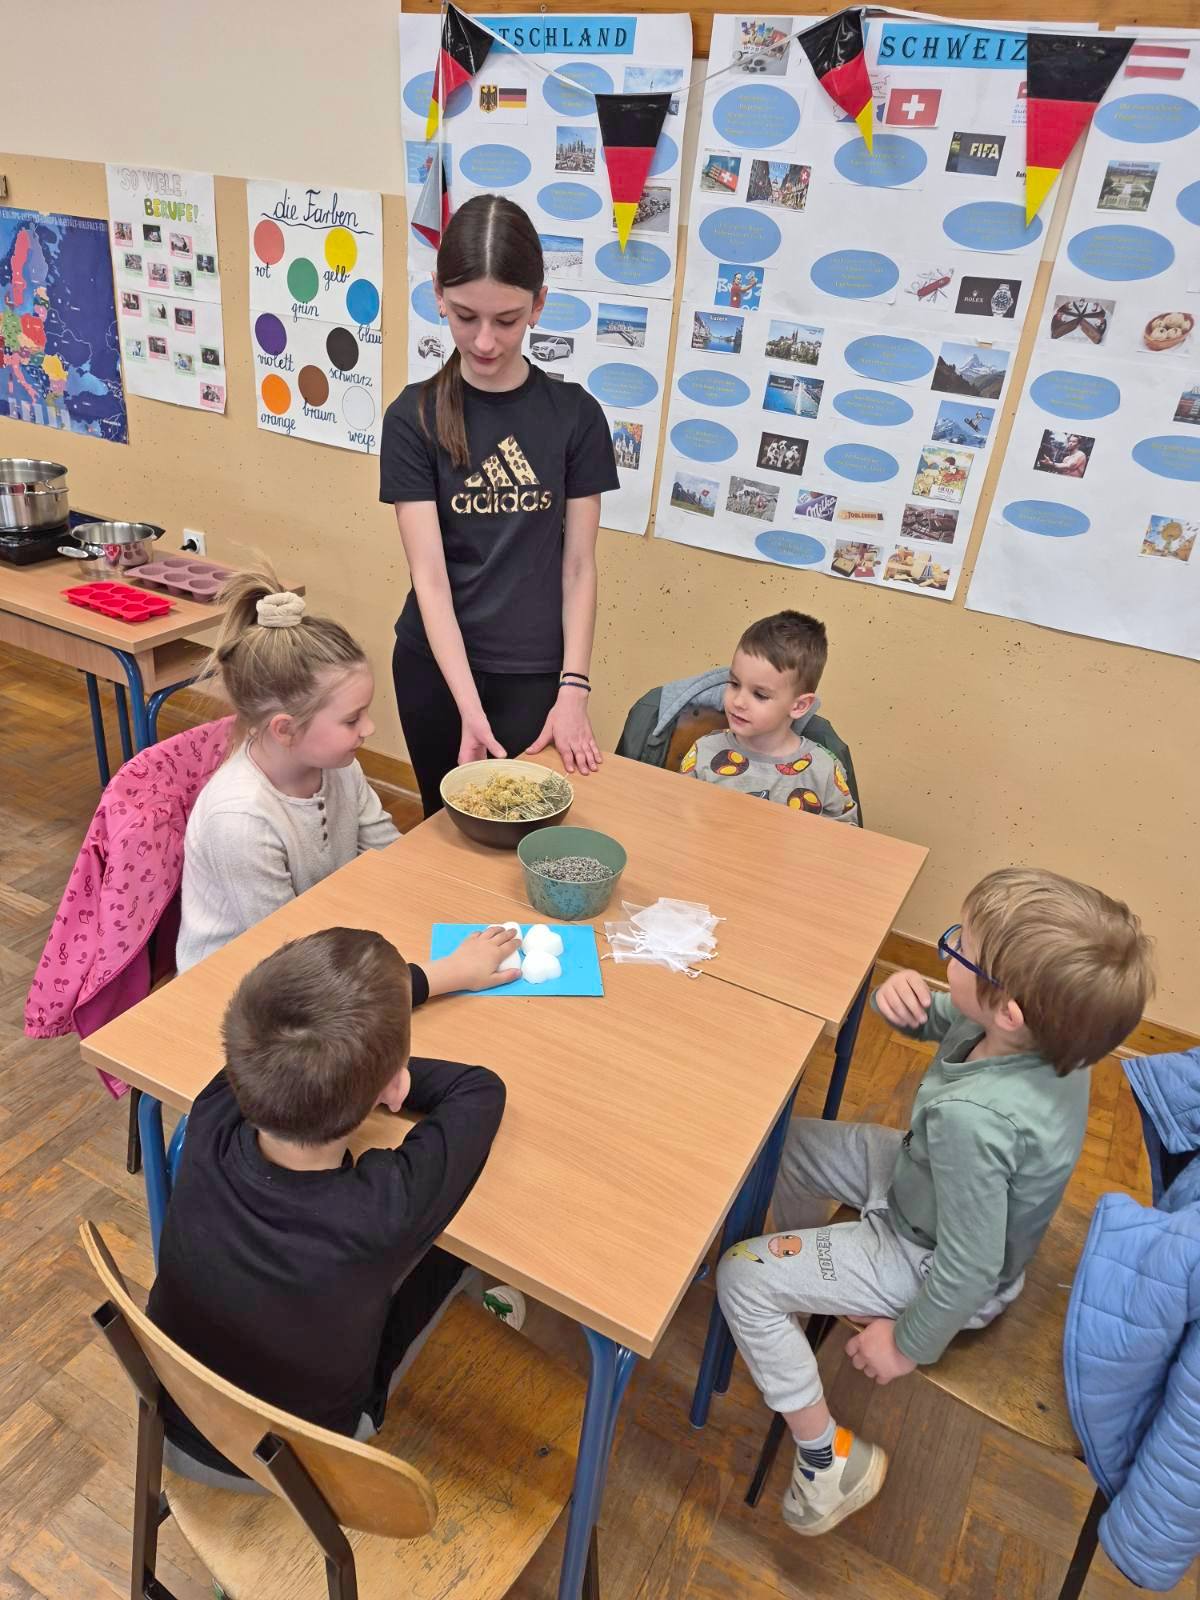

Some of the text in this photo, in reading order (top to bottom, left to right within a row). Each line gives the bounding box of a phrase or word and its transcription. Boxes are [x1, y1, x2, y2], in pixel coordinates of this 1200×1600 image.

[491, 27, 628, 48] TSCHLAND
[880, 33, 1028, 61] SCHWEIZ
[969, 142, 1000, 160] FIFA
[120, 168, 182, 197] SO VIELE
[144, 198, 199, 223] BERUFE!
[272, 189, 359, 228] die Farben
[255, 264, 271, 279] rot
[323, 265, 350, 290] gelb
[291, 301, 320, 322] grün
[357, 323, 383, 345] blau
[257, 351, 295, 373] violett
[328, 366, 373, 388] schwarz
[302, 396, 337, 424] braun
[261, 411, 296, 433] orange
[347, 427, 376, 454] weiß
[450, 485, 552, 514] adidas
[806, 496, 837, 519] Milka
